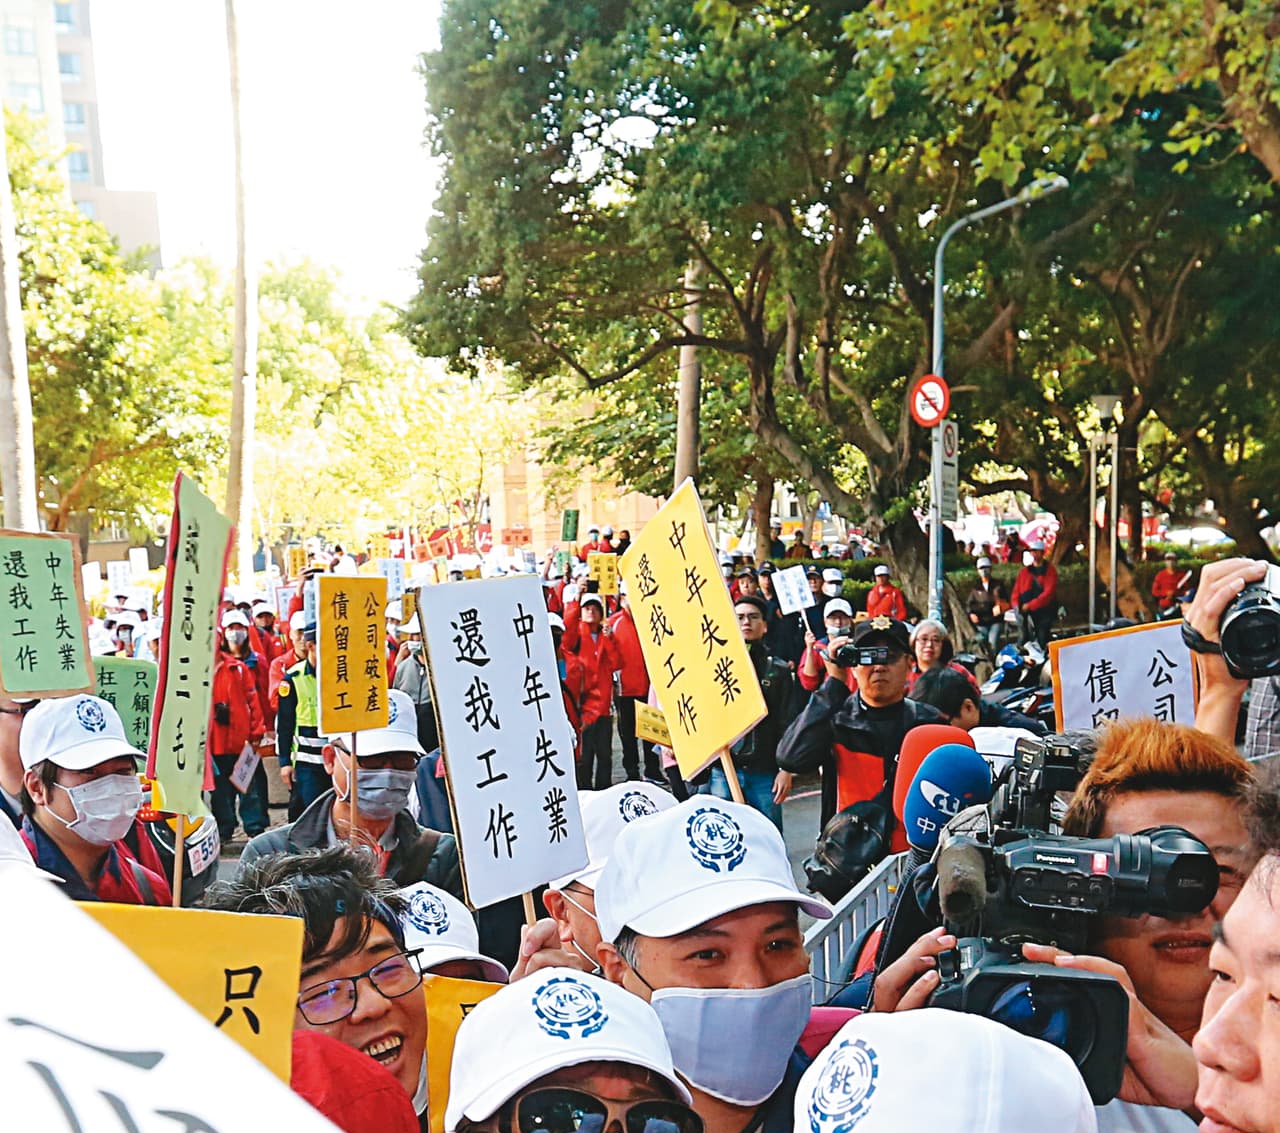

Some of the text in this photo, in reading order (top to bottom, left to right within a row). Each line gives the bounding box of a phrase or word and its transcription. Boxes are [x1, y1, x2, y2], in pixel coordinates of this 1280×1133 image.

[3, 551, 38, 673] 還我工作
[45, 551, 76, 671] 中年失業
[331, 591, 353, 711] 債留員工
[362, 591, 382, 713] 公司破產
[635, 552, 698, 737] 還我工作
[669, 520, 742, 707] 中年失業
[450, 606, 518, 860] 還我工作
[513, 602, 568, 845] 中年失業
[1147, 649, 1178, 724] 公司
[1036, 853, 1076, 865] Panasonic
[213, 965, 263, 1035] 只
